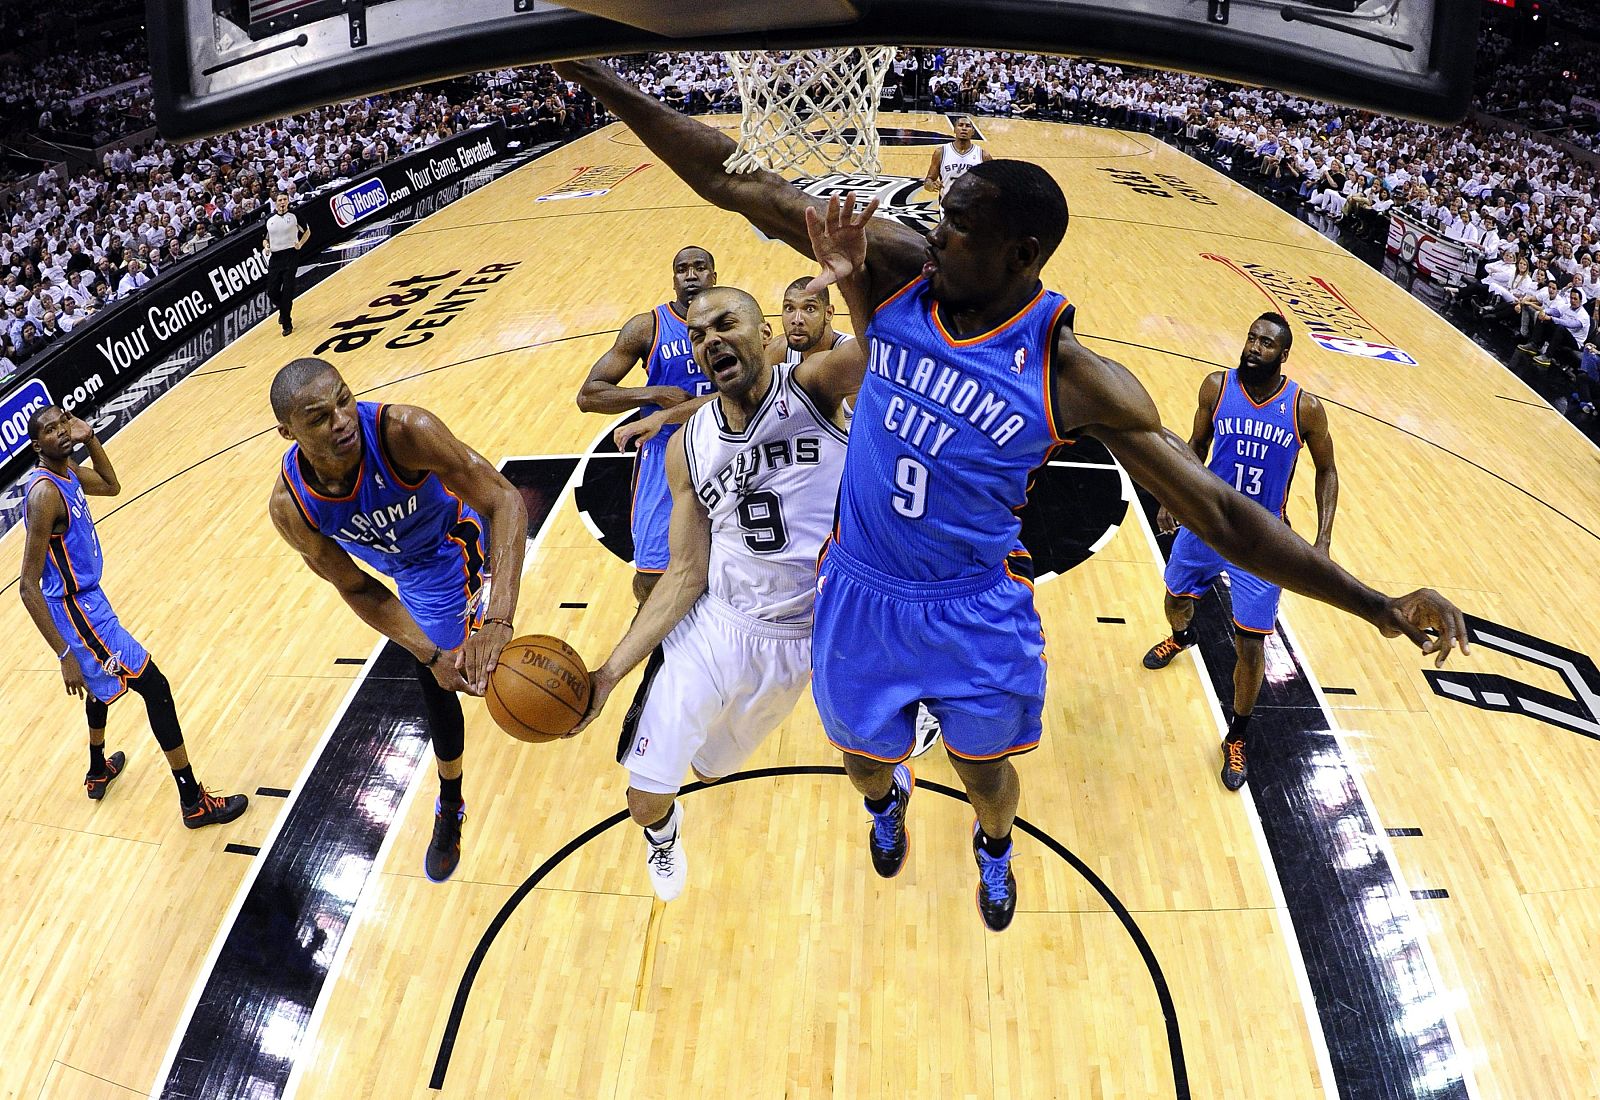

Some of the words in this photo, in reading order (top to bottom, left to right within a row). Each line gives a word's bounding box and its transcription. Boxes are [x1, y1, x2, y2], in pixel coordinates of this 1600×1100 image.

[351, 186, 385, 214] iHoops
[388, 186, 411, 204] .com
[405, 167, 432, 191] Your
[429, 155, 461, 181] Game.
[456, 137, 497, 169] Elevated.
[61, 373, 104, 414] .com
[96, 323, 151, 375] Your
[148, 289, 213, 341] Game.
[208, 246, 272, 303] Elevat
[312, 269, 462, 355] at&t
[385, 261, 523, 349] CENTER
[661, 339, 694, 360] OKL
[869, 337, 1026, 448] OKLAHOMA
[884, 395, 957, 458] CITY
[1217, 417, 1295, 449] OKLAHOMA
[1236, 439, 1269, 460] CITY
[699, 436, 823, 511] SPURS
[891, 456, 930, 519] 9
[1234, 462, 1265, 495] 13
[737, 489, 790, 553] 9
